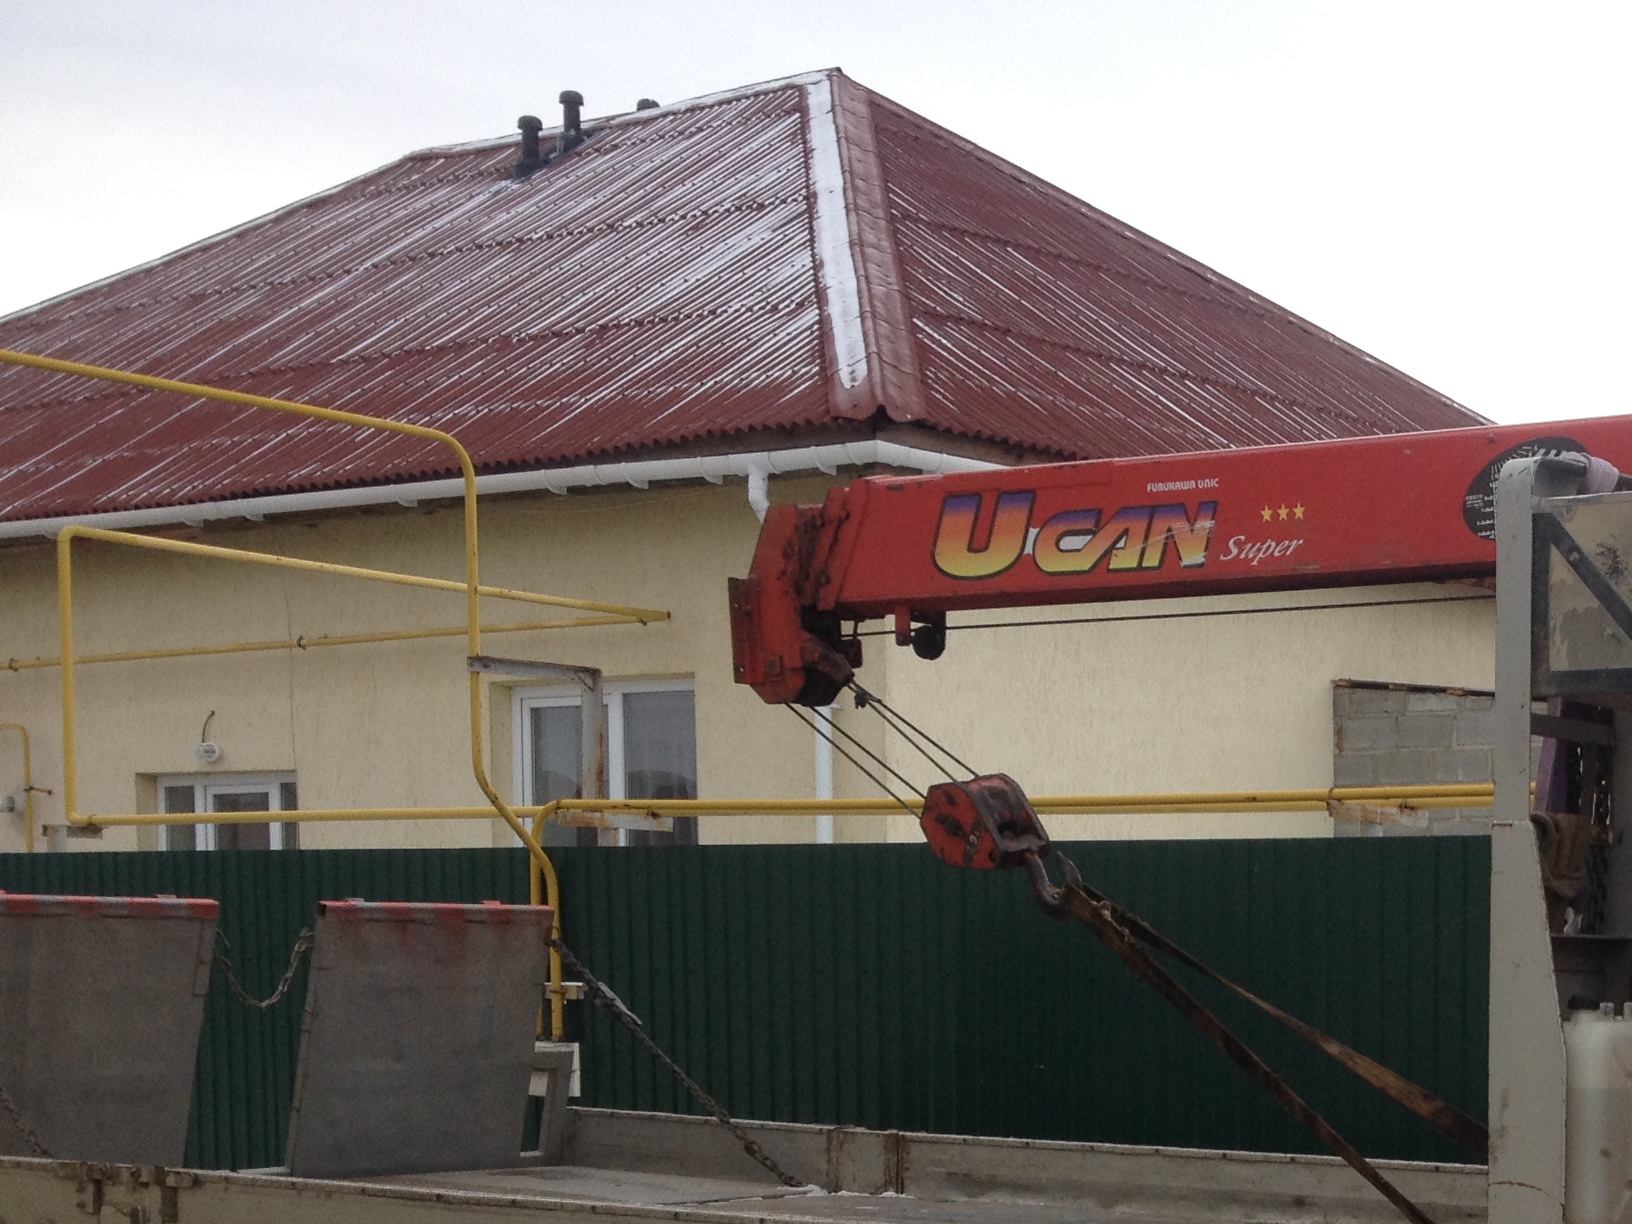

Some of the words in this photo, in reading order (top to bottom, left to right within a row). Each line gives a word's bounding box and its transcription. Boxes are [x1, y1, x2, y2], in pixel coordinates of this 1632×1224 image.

[1147, 481, 1196, 493] FURUKAWA
[1197, 478, 1220, 489] UNIC
[1219, 535, 1304, 566] Super
